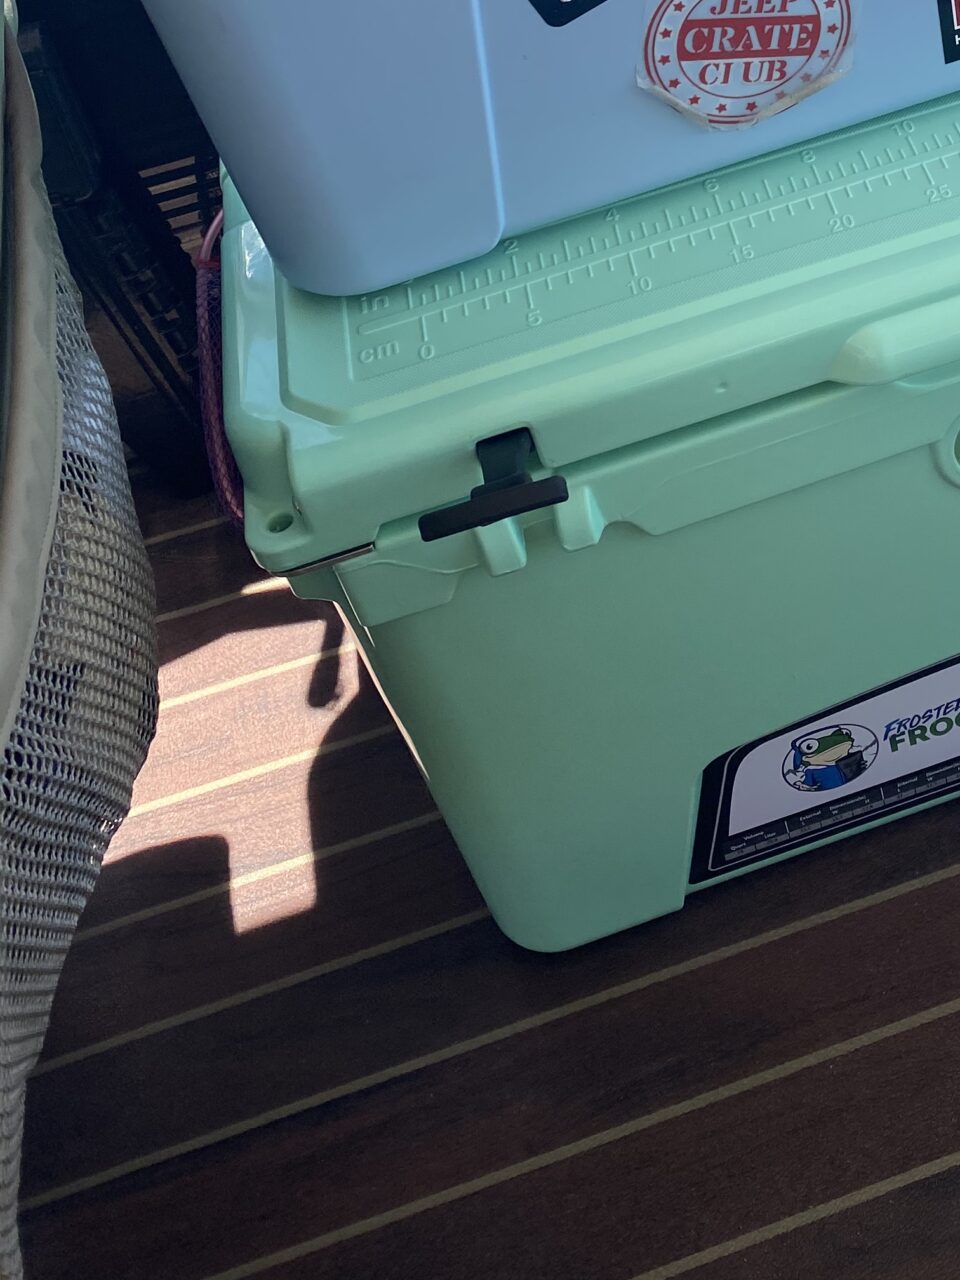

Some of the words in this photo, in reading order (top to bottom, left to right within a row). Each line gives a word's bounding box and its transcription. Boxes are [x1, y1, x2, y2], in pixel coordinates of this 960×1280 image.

[684, 22, 814, 54] CRATE
[360, 294, 390, 315] in
[504, 238, 519, 255] 2
[605, 207, 620, 221] 4
[703, 177, 720, 193] 6
[801, 149, 816, 164] 8
[890, 120, 915, 136] 10
[360, 339, 401, 364] cm
[527, 309, 543, 327] 5
[626, 276, 653, 295] 10
[729, 244, 755, 264] 15
[829, 213, 855, 233] 20
[925, 183, 952, 203] 25
